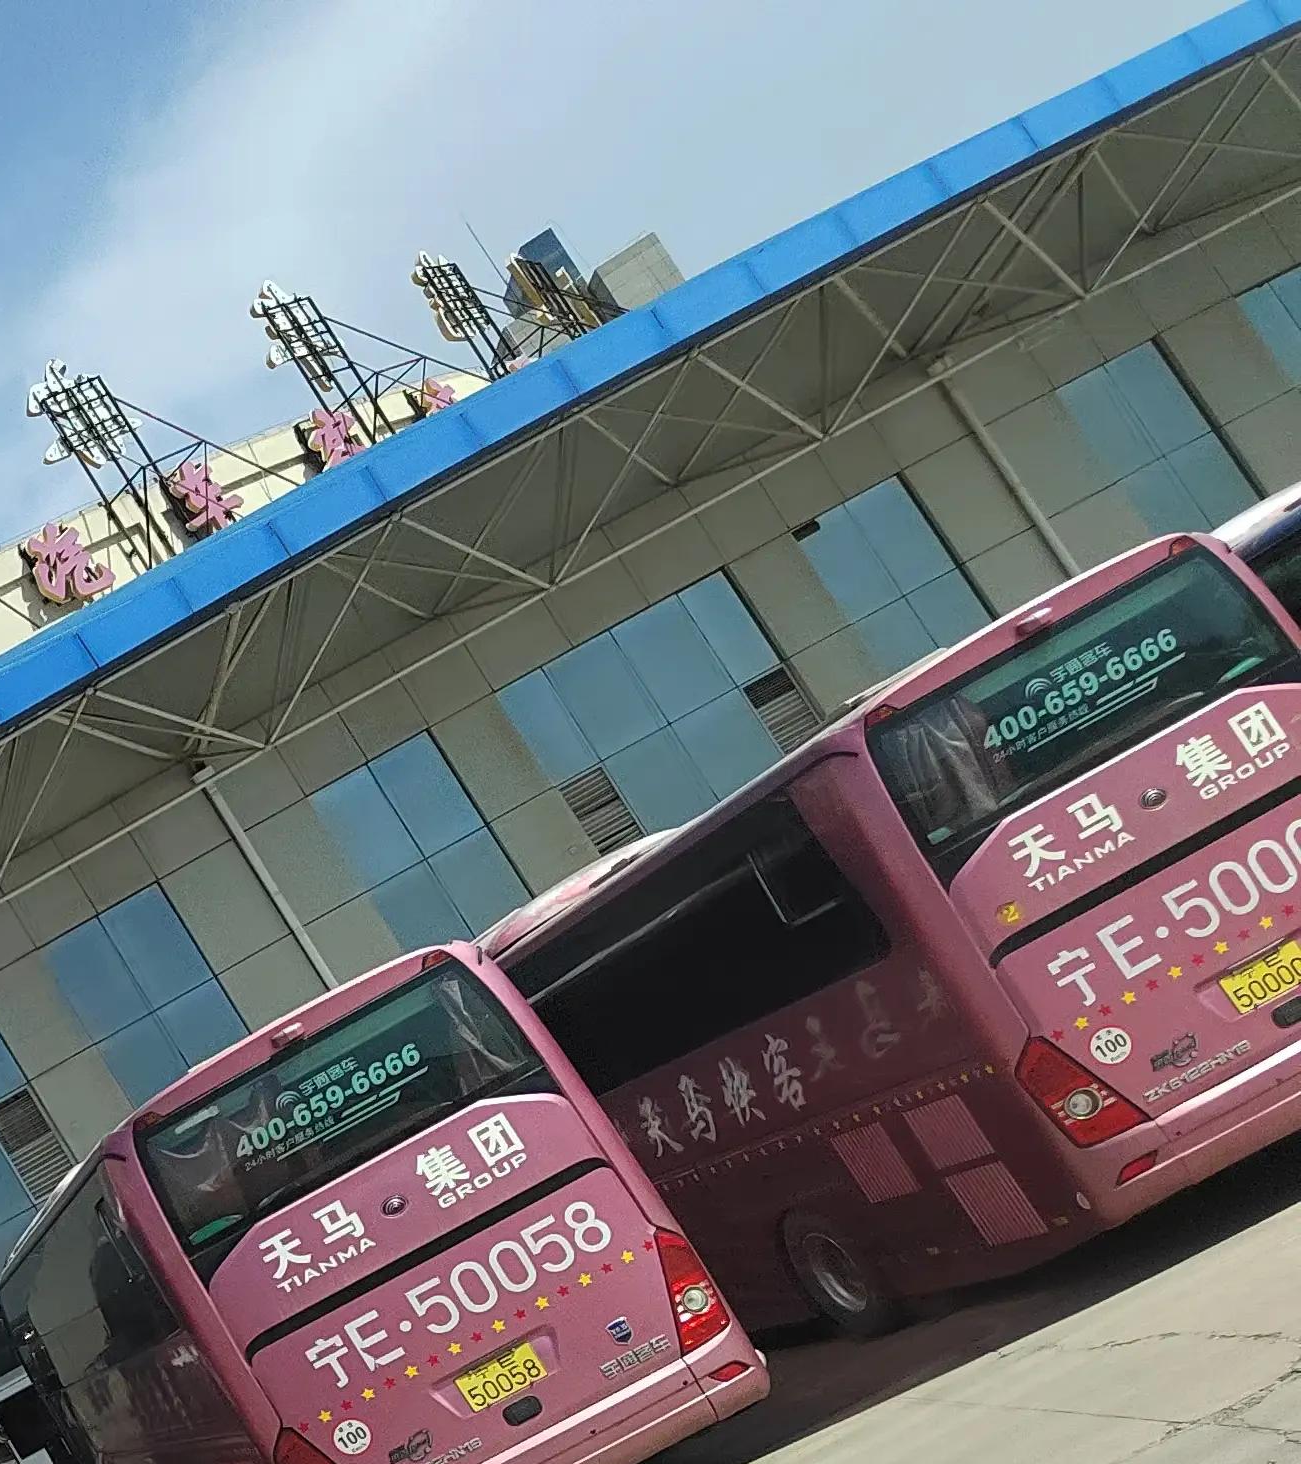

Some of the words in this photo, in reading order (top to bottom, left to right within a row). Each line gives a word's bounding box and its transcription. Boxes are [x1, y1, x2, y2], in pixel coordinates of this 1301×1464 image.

[983, 628, 1177, 750] 400-659-6666
[1027, 832, 1136, 892] TIANMA
[1199, 742, 1291, 800] GROUP
[236, 1043, 421, 1158] 400-659-6666
[1095, 1033, 1128, 1058] 100
[276, 1238, 376, 1294] TIANMA
[437, 1152, 528, 1209] GROUP
[338, 1426, 367, 1448] 100
[468, 1359, 543, 1407] 50058
